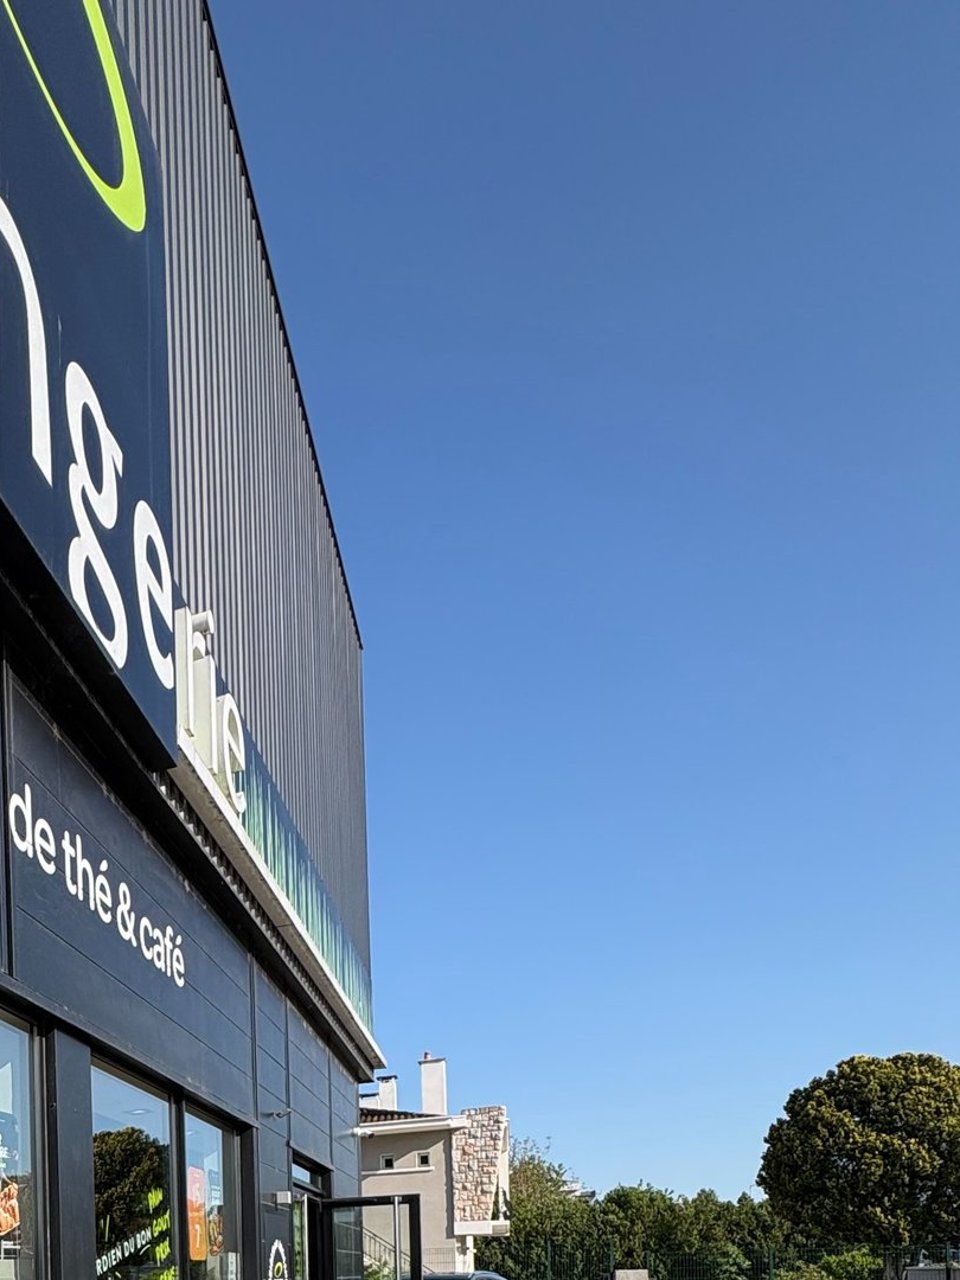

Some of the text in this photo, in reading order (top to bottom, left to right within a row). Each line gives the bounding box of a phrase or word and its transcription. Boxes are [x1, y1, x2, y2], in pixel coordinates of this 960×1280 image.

[9, 784, 56, 875] de
[62, 830, 111, 924] thé
[117, 882, 137, 947] &
[140, 925, 185, 987] café
[123, 1236, 135, 1257] DU
[135, 1225, 152, 1249] BON
